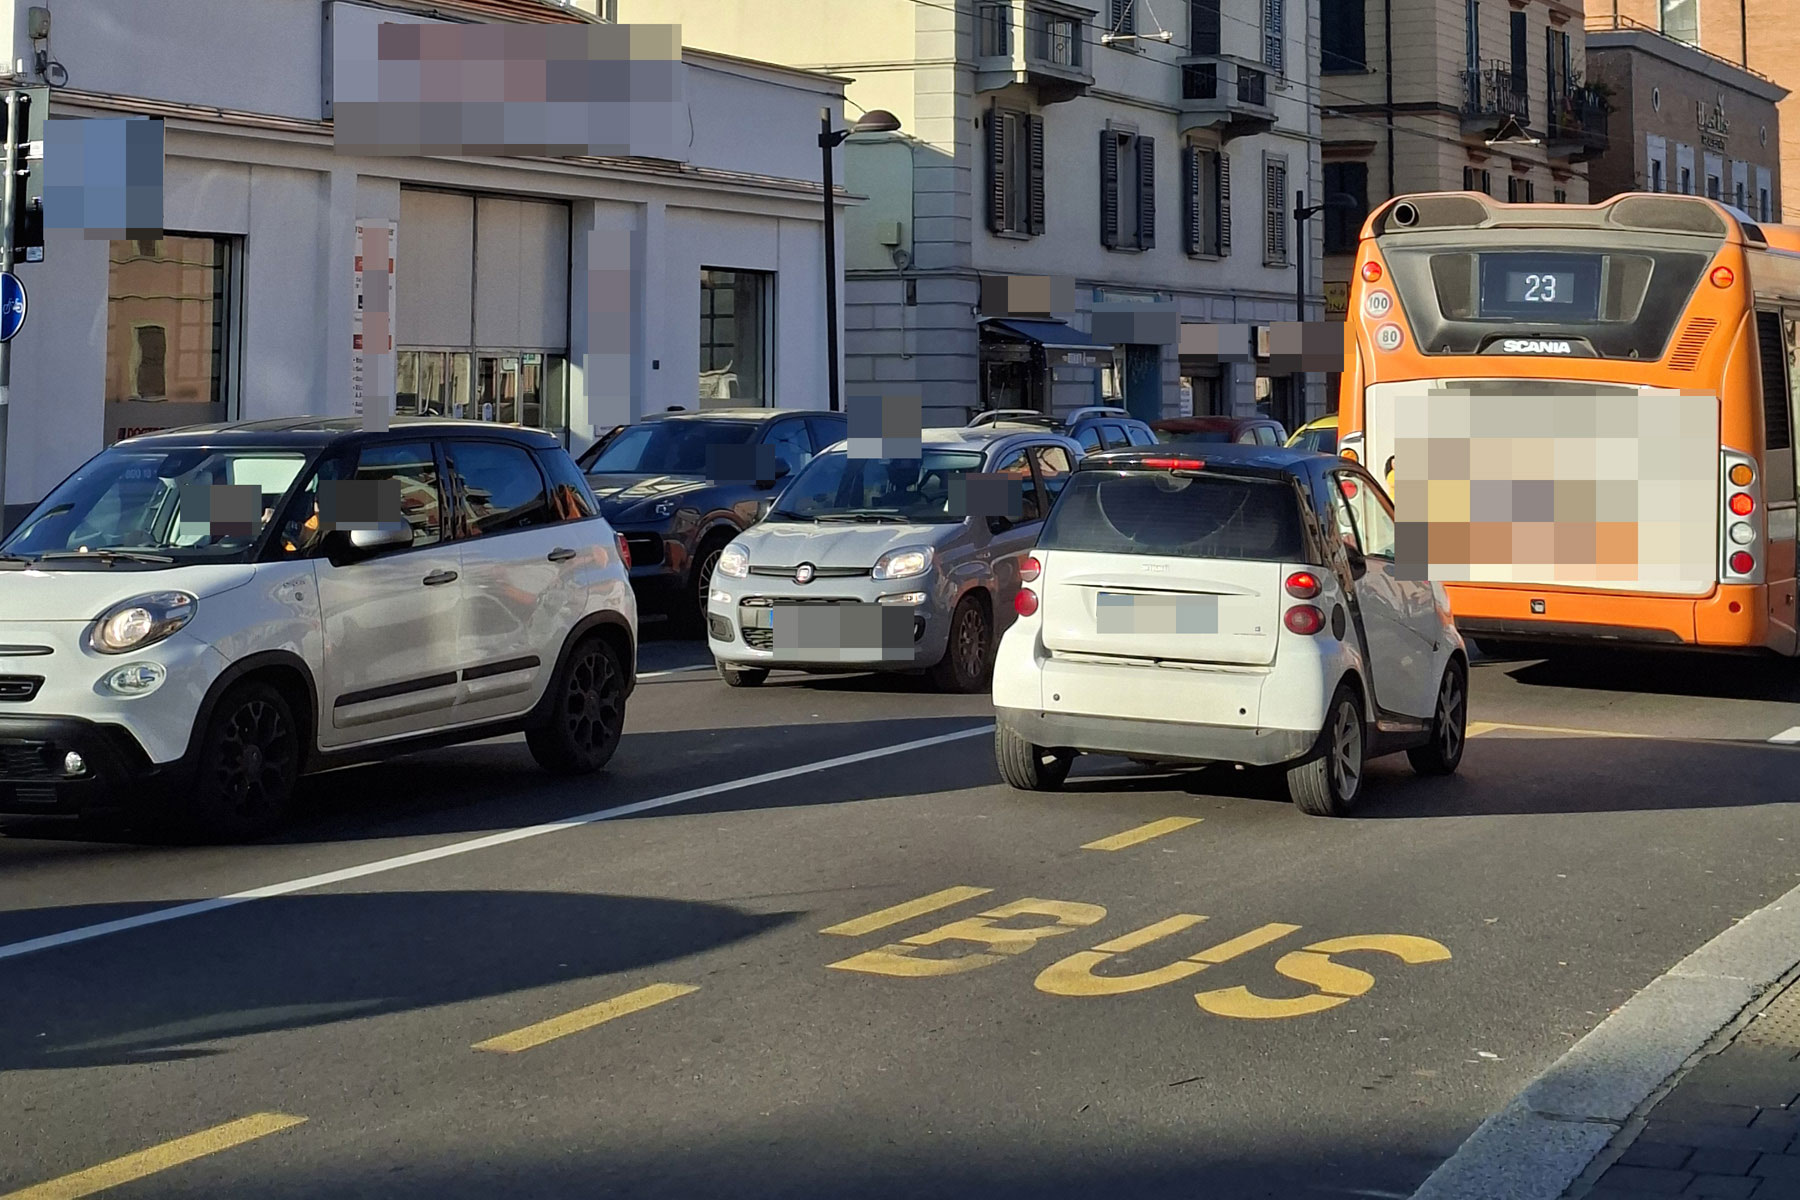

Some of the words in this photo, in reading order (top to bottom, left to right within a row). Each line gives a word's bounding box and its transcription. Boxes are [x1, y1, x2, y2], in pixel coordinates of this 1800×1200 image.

[1524, 274, 1557, 302] 23
[1368, 296, 1389, 310] 100
[1382, 330, 1398, 343] 80
[1503, 340, 1571, 354] SCANIA
